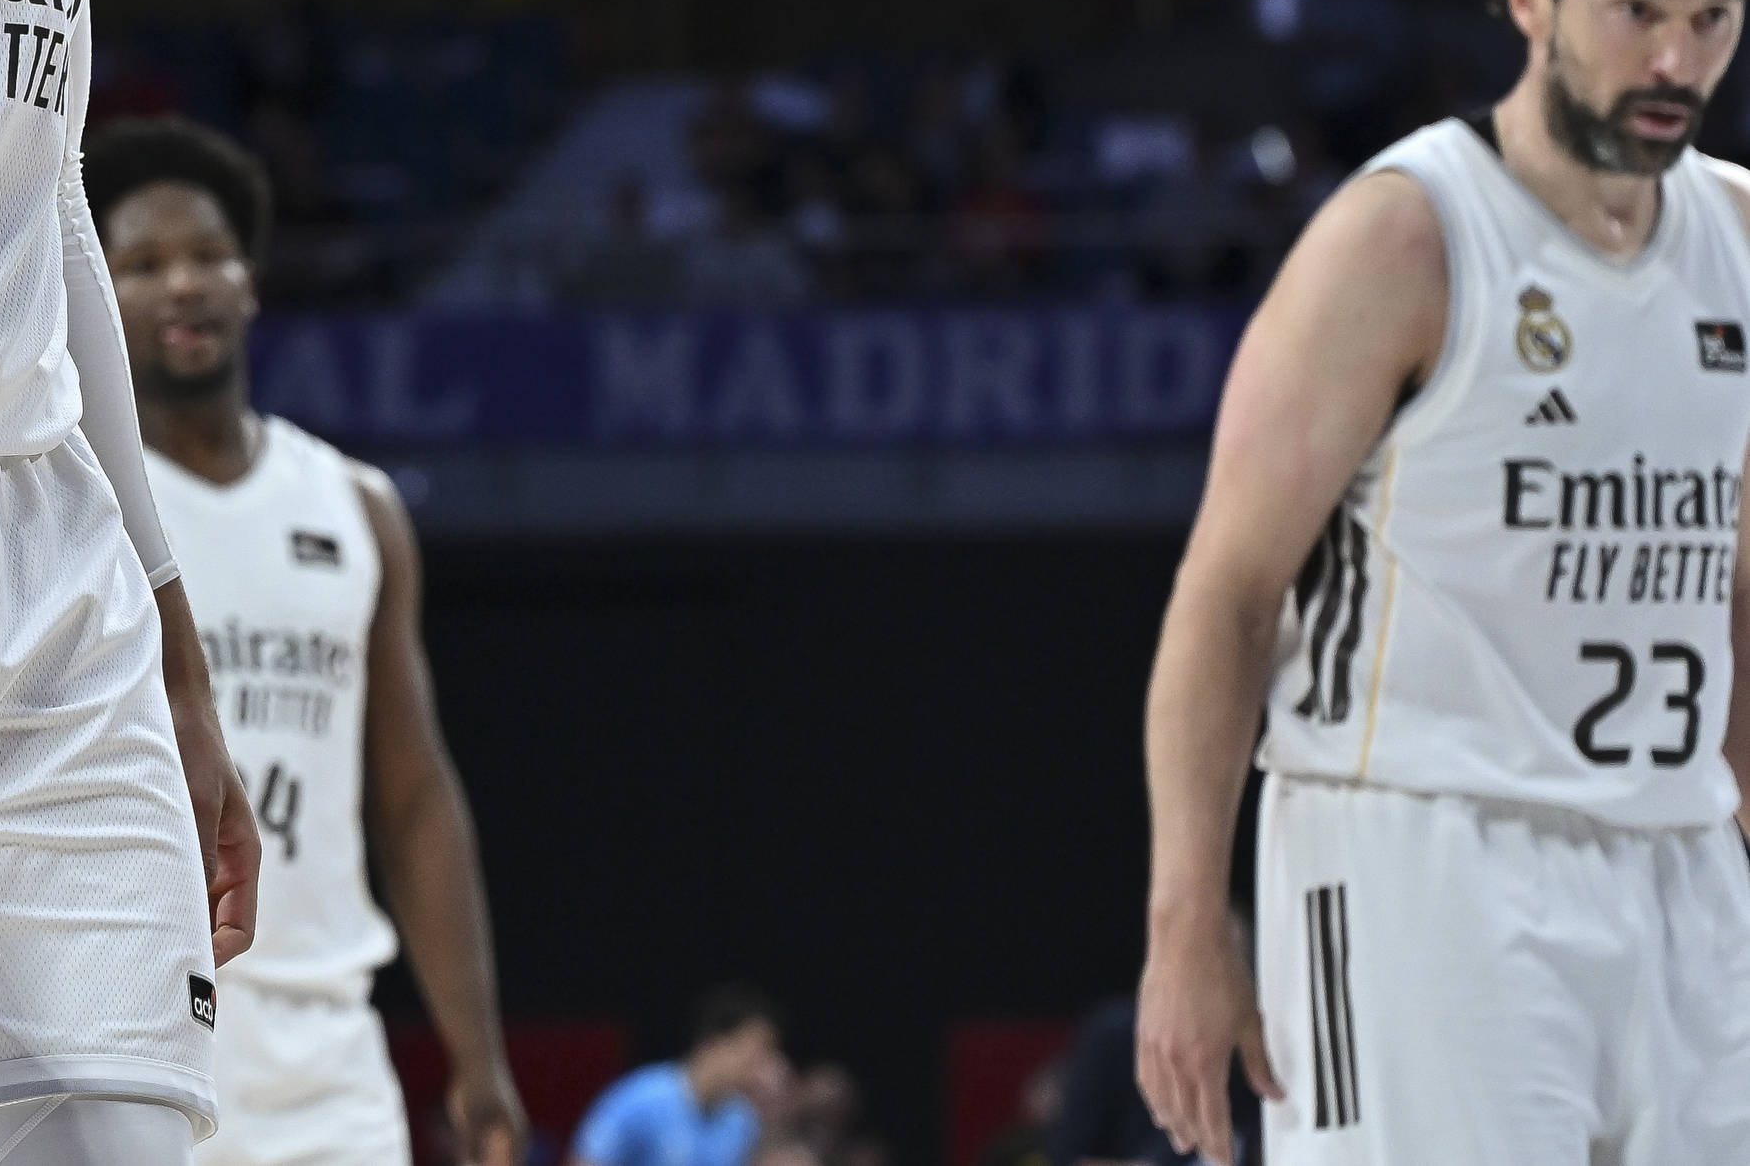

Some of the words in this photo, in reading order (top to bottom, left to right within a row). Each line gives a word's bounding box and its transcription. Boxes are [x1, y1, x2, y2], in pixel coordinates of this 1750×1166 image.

[258, 320, 486, 434] AL
[590, 311, 1218, 438] MADRID
[1503, 451, 1741, 531] Emirat
[1546, 542, 1620, 604] FLY
[1628, 541, 1732, 604] BETTE
[1572, 640, 1706, 767] 23
[236, 758, 300, 865] 4
[194, 996, 214, 1022] acb
